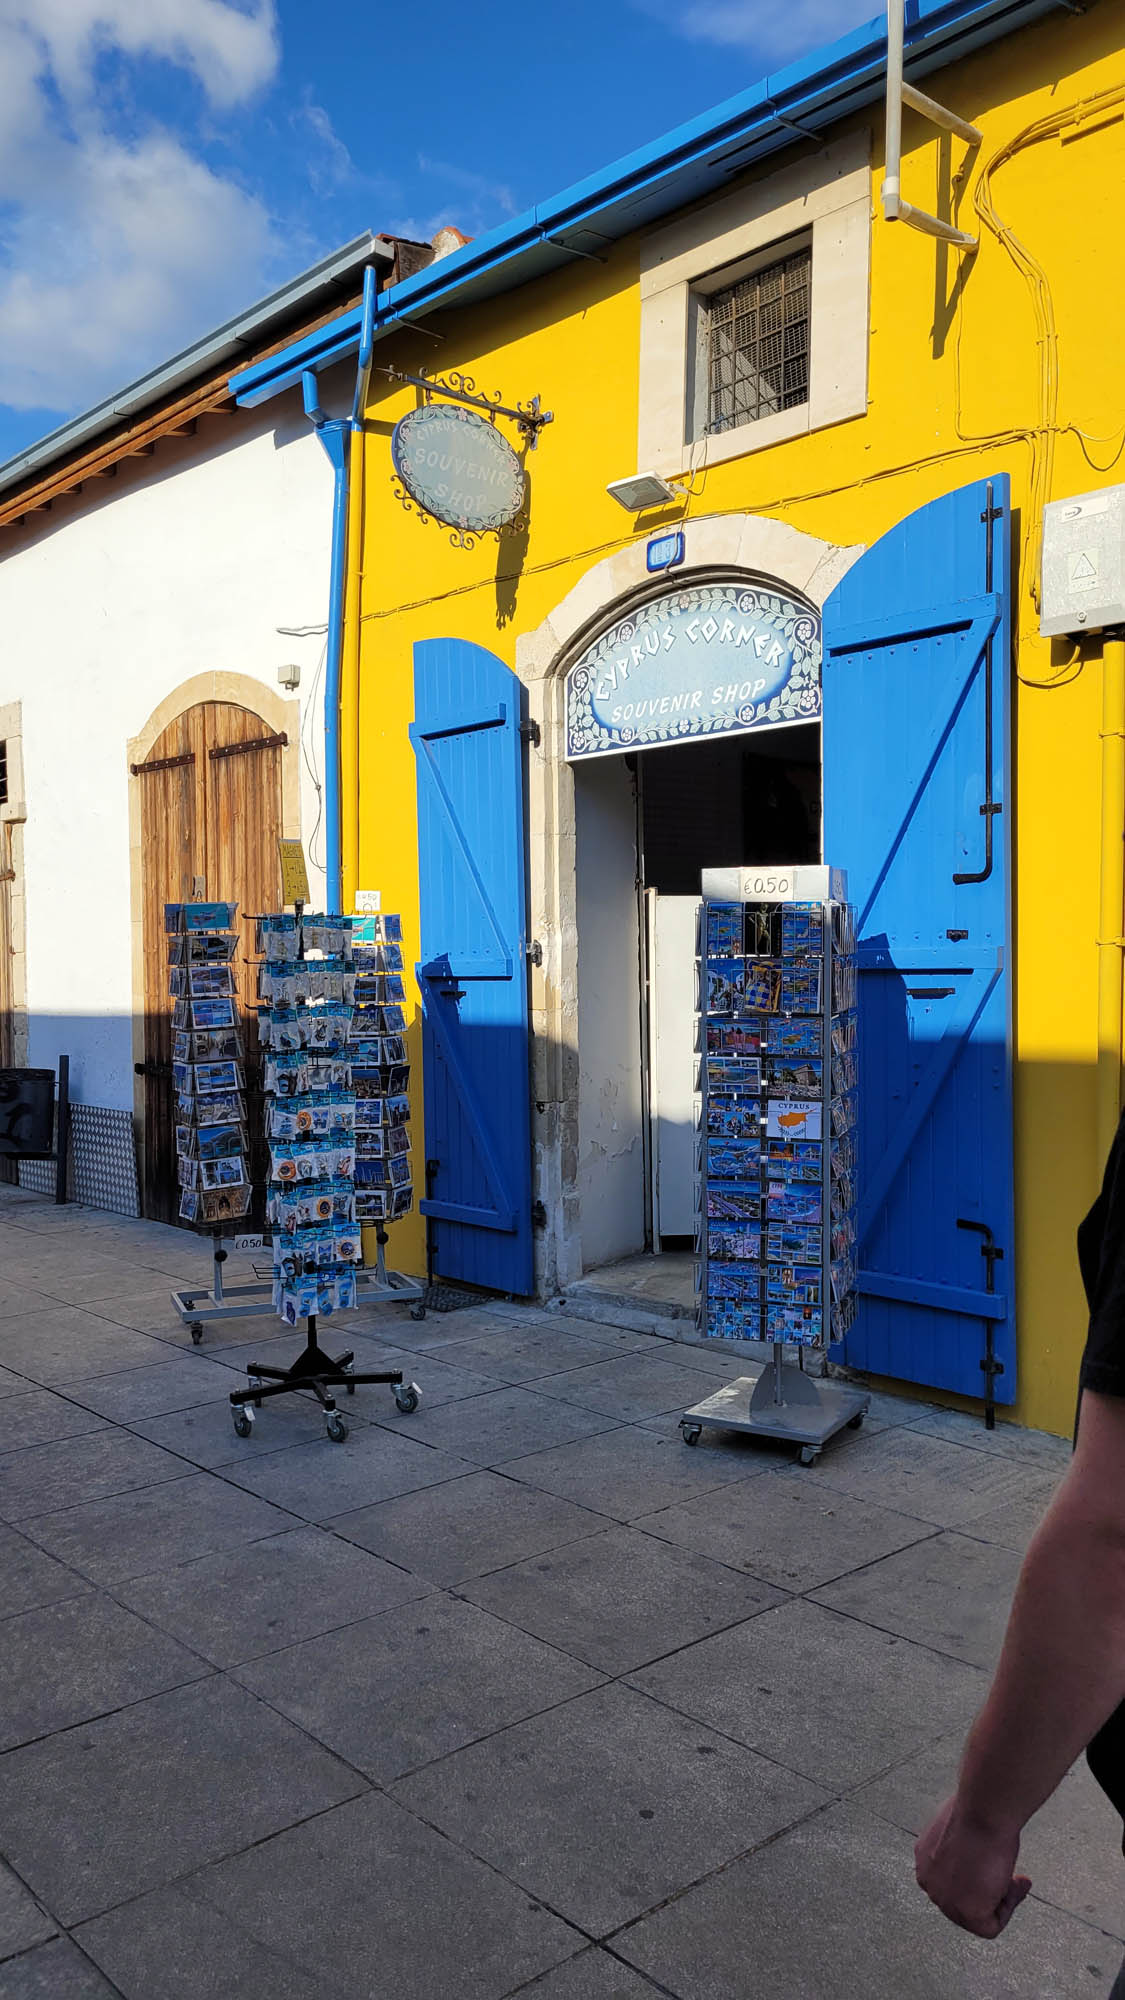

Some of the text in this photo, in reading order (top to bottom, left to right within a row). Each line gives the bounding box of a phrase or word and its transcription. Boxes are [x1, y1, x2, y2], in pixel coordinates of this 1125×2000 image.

[415, 448, 509, 487] SOUVENIR
[434, 483, 488, 512] SHOP
[596, 616, 785, 702] CYPRUS CORNER
[611, 678, 767, 723] SOUVENIR SHOP
[743, 877, 789, 895] €0.50
[778, 1102, 810, 1110] CYPRUS
